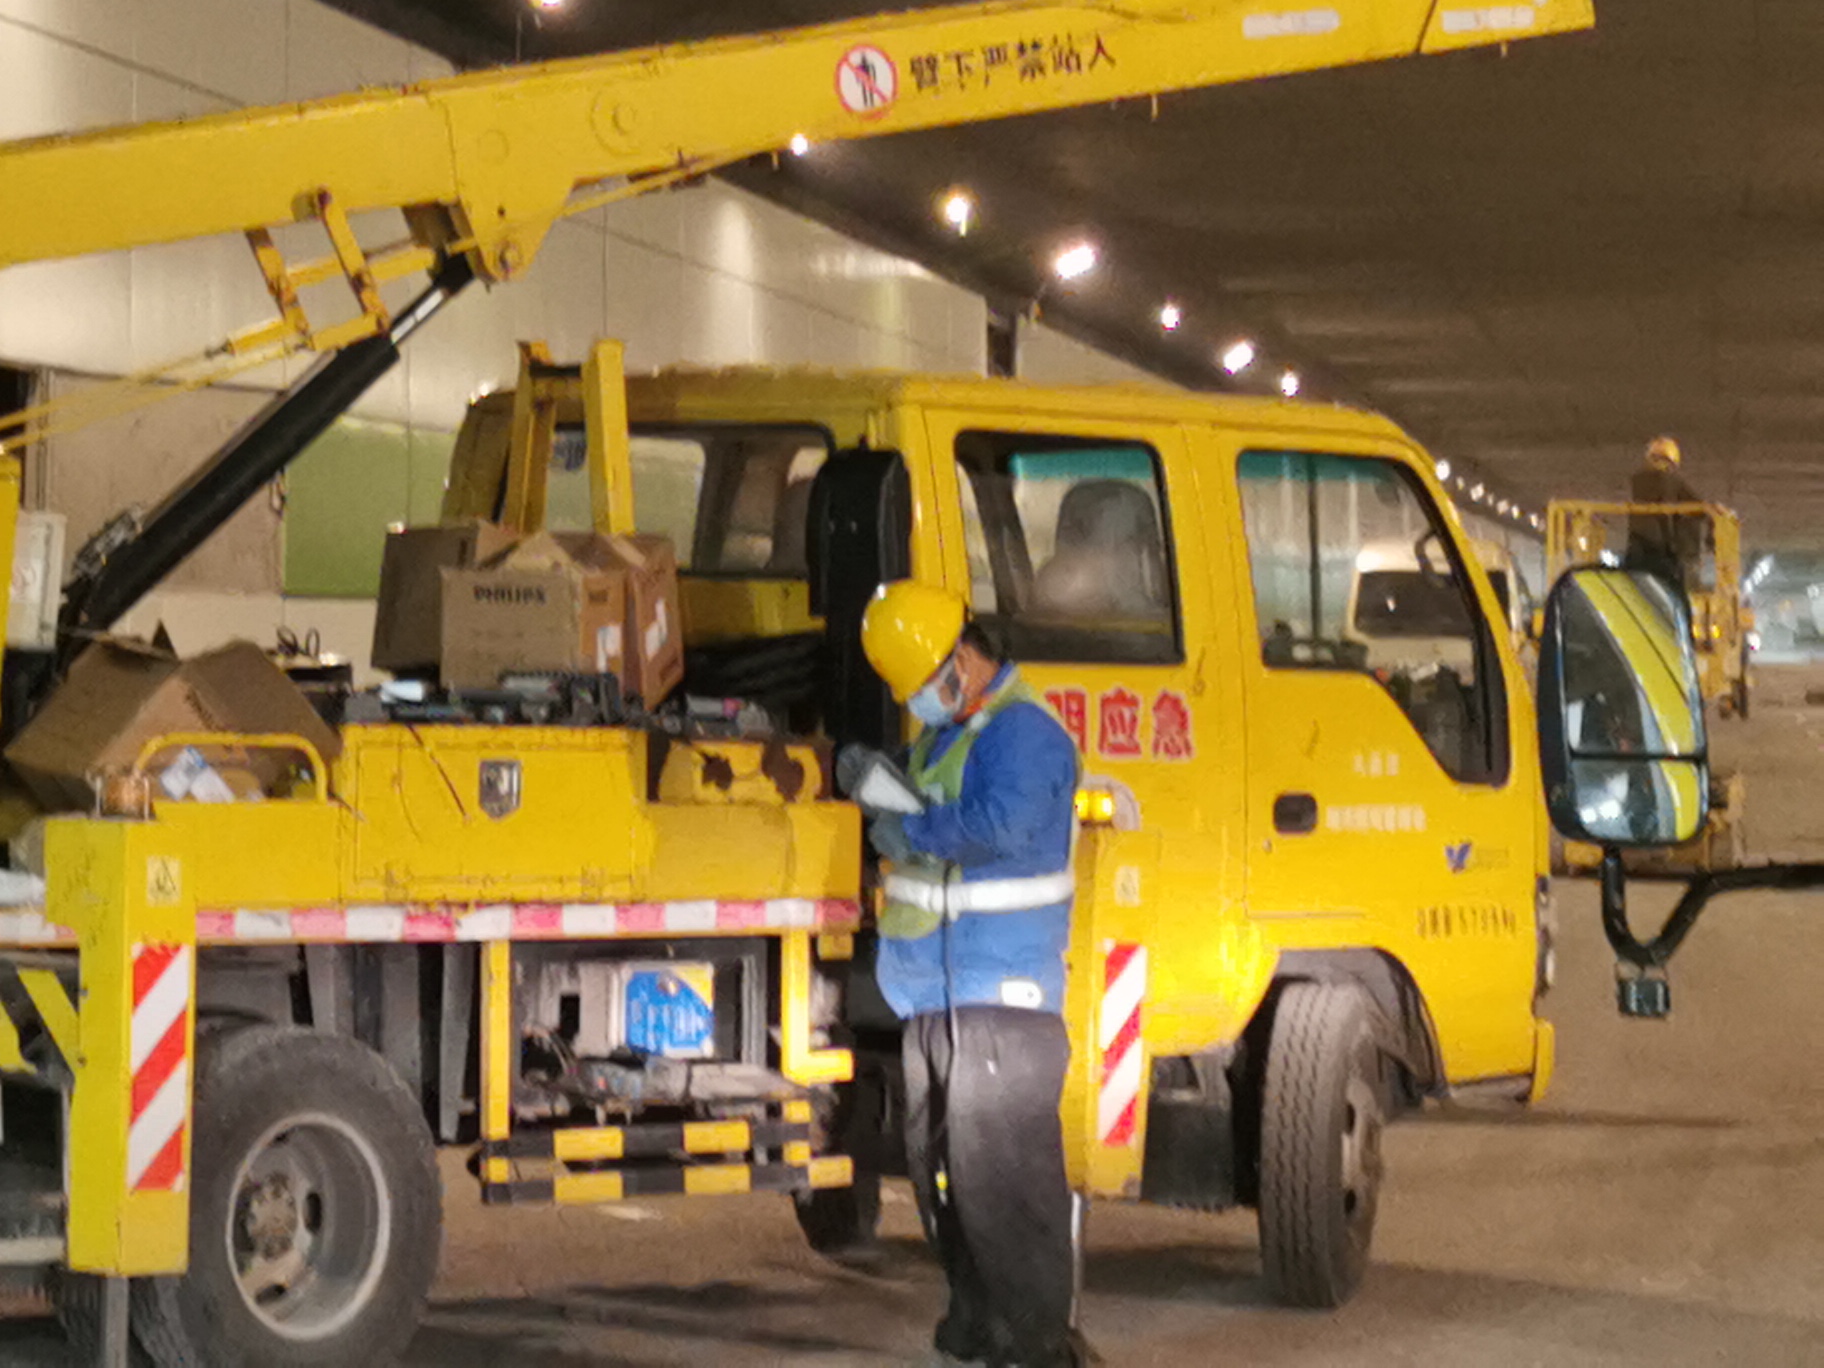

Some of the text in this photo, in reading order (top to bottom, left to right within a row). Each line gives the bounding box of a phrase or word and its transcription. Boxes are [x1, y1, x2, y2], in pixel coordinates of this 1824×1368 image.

[909, 31, 1116, 93] 臂下严禁站人
